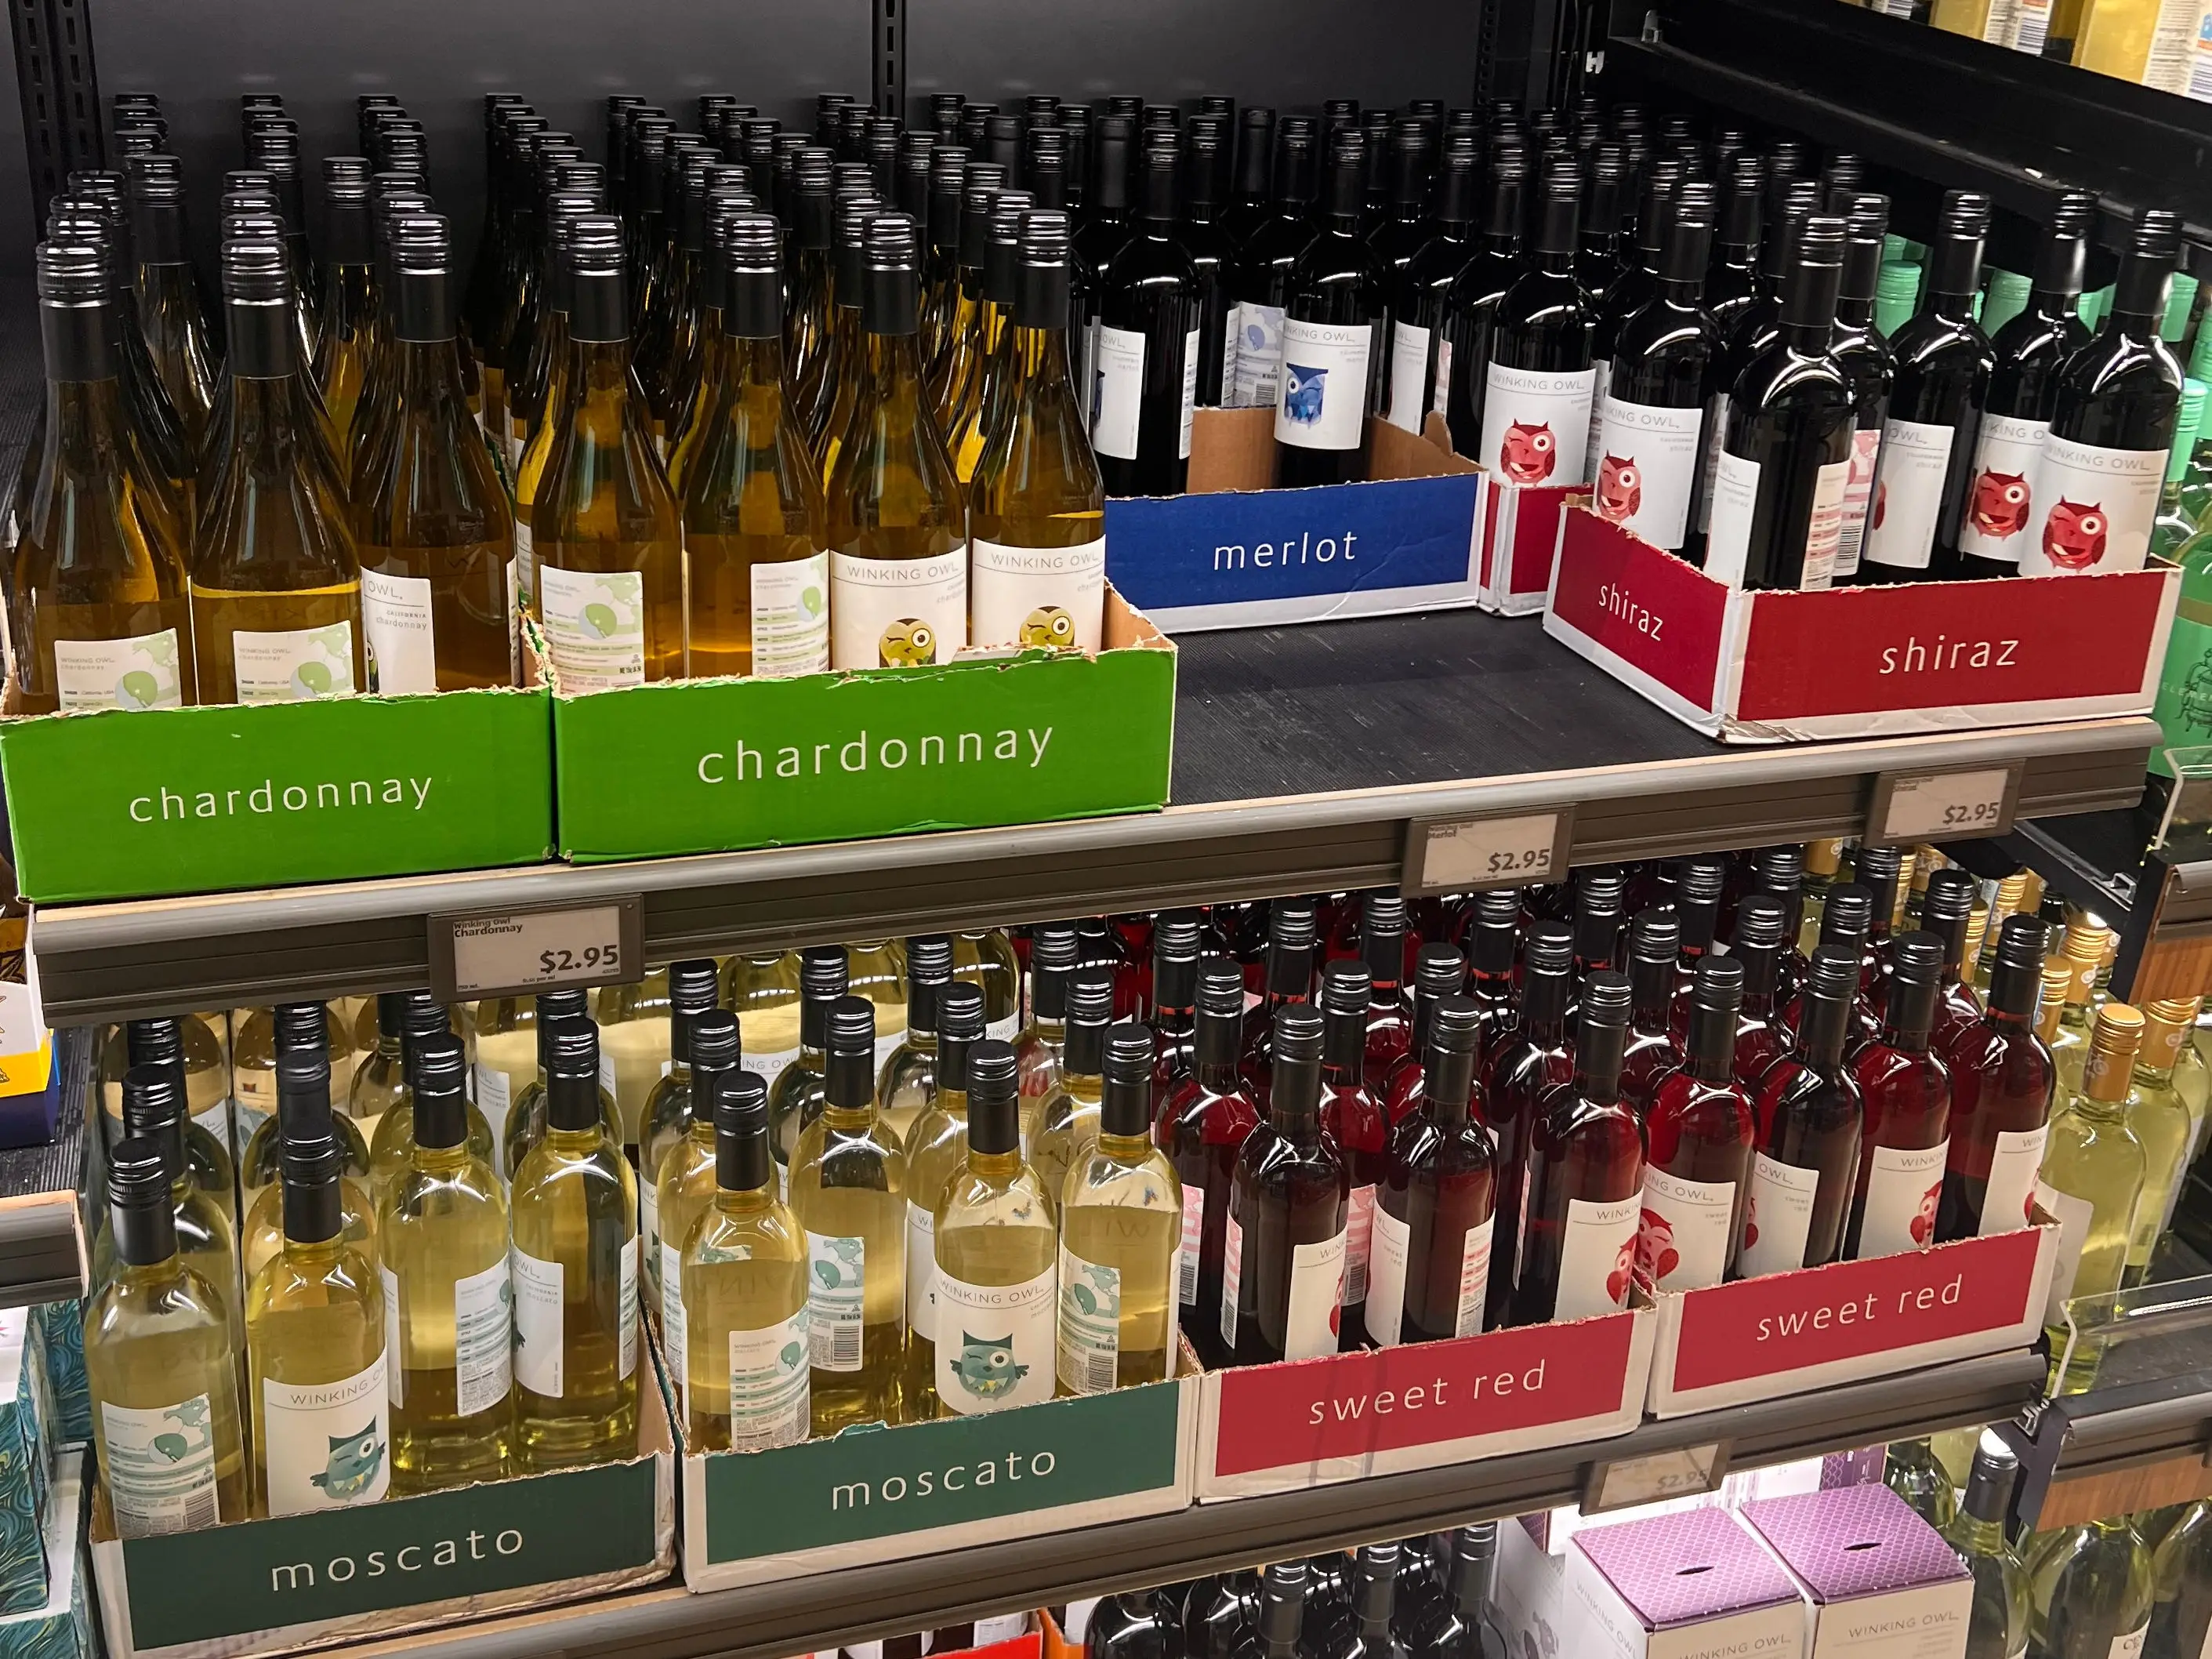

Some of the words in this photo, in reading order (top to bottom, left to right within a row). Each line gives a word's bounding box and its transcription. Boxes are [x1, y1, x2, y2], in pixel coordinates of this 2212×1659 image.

[1492, 372, 1549, 390] WINKING
[991, 553, 1064, 569] WINKING
[1070, 551, 1099, 567] OWL
[1214, 532, 1357, 570] merlot
[847, 564, 921, 581] WINKING
[928, 561, 959, 578] OWL
[375, 615, 428, 632] chardonnay
[1598, 581, 1663, 641] shiraz
[1880, 637, 2018, 673] shiraz
[698, 728, 1053, 782] chardonnay
[130, 778, 431, 822] chardonnay
[1942, 801, 2000, 825] $2.95
[1487, 848, 1550, 873] $2.95
[453, 917, 491, 930] Winking
[492, 917, 511, 926] Owl
[454, 924, 523, 938] Chardonnay
[539, 943, 619, 975] $2.95
[986, 1025, 1010, 1040] KING
[941, 1277, 1003, 1305] WINKING
[1757, 1293, 1877, 1341] sweet
[1898, 1274, 1962, 1314] red
[290, 1379, 368, 1405] WINKING
[1308, 1377, 1449, 1425] sweet
[1473, 1359, 1545, 1400] red
[832, 1450, 1056, 1510] moscato
[271, 1528, 524, 1592] moscato
[1576, 1578, 1614, 1633] WINKING
[1848, 1617, 1916, 1639] WINKING
[1922, 1610, 1960, 1625] OWL
[1754, 1633, 1792, 1650] OWL
